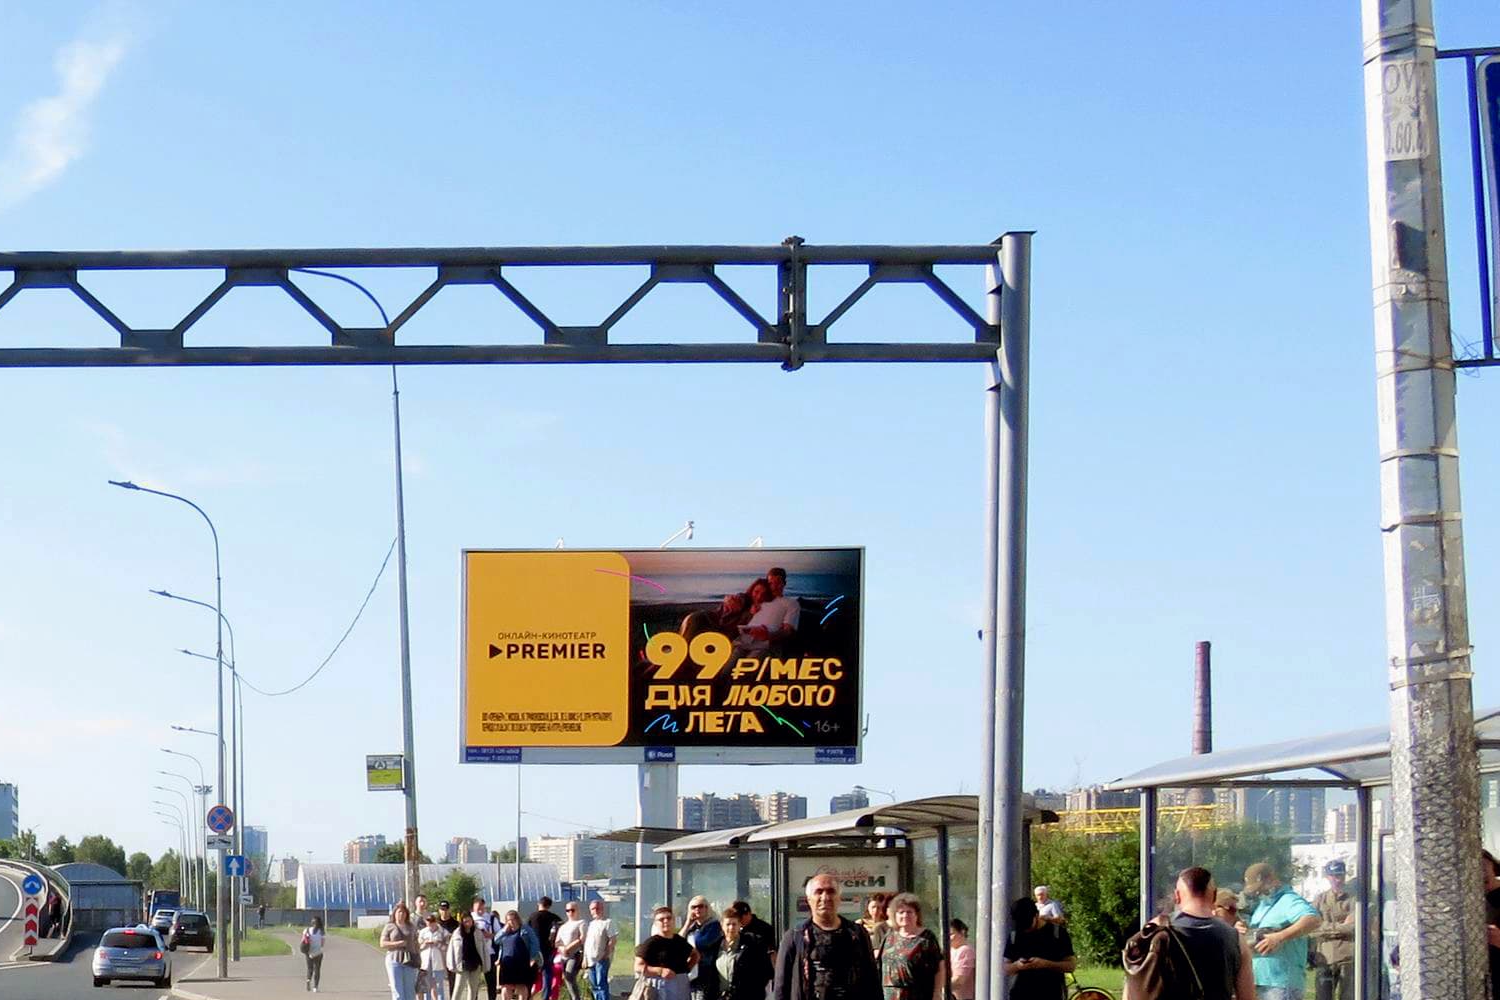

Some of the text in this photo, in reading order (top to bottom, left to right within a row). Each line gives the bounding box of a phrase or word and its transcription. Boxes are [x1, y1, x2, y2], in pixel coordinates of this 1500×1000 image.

[497, 631, 597, 640] ОНЛАЙН-КИНОТЕАТР
[506, 643, 606, 659] PREMIER
[645, 632, 732, 680] 99
[645, 685, 835, 710] ДЛЯ ЛЮБОГО
[685, 711, 764, 733] ЛЕТА
[814, 720, 840, 732] 16+
